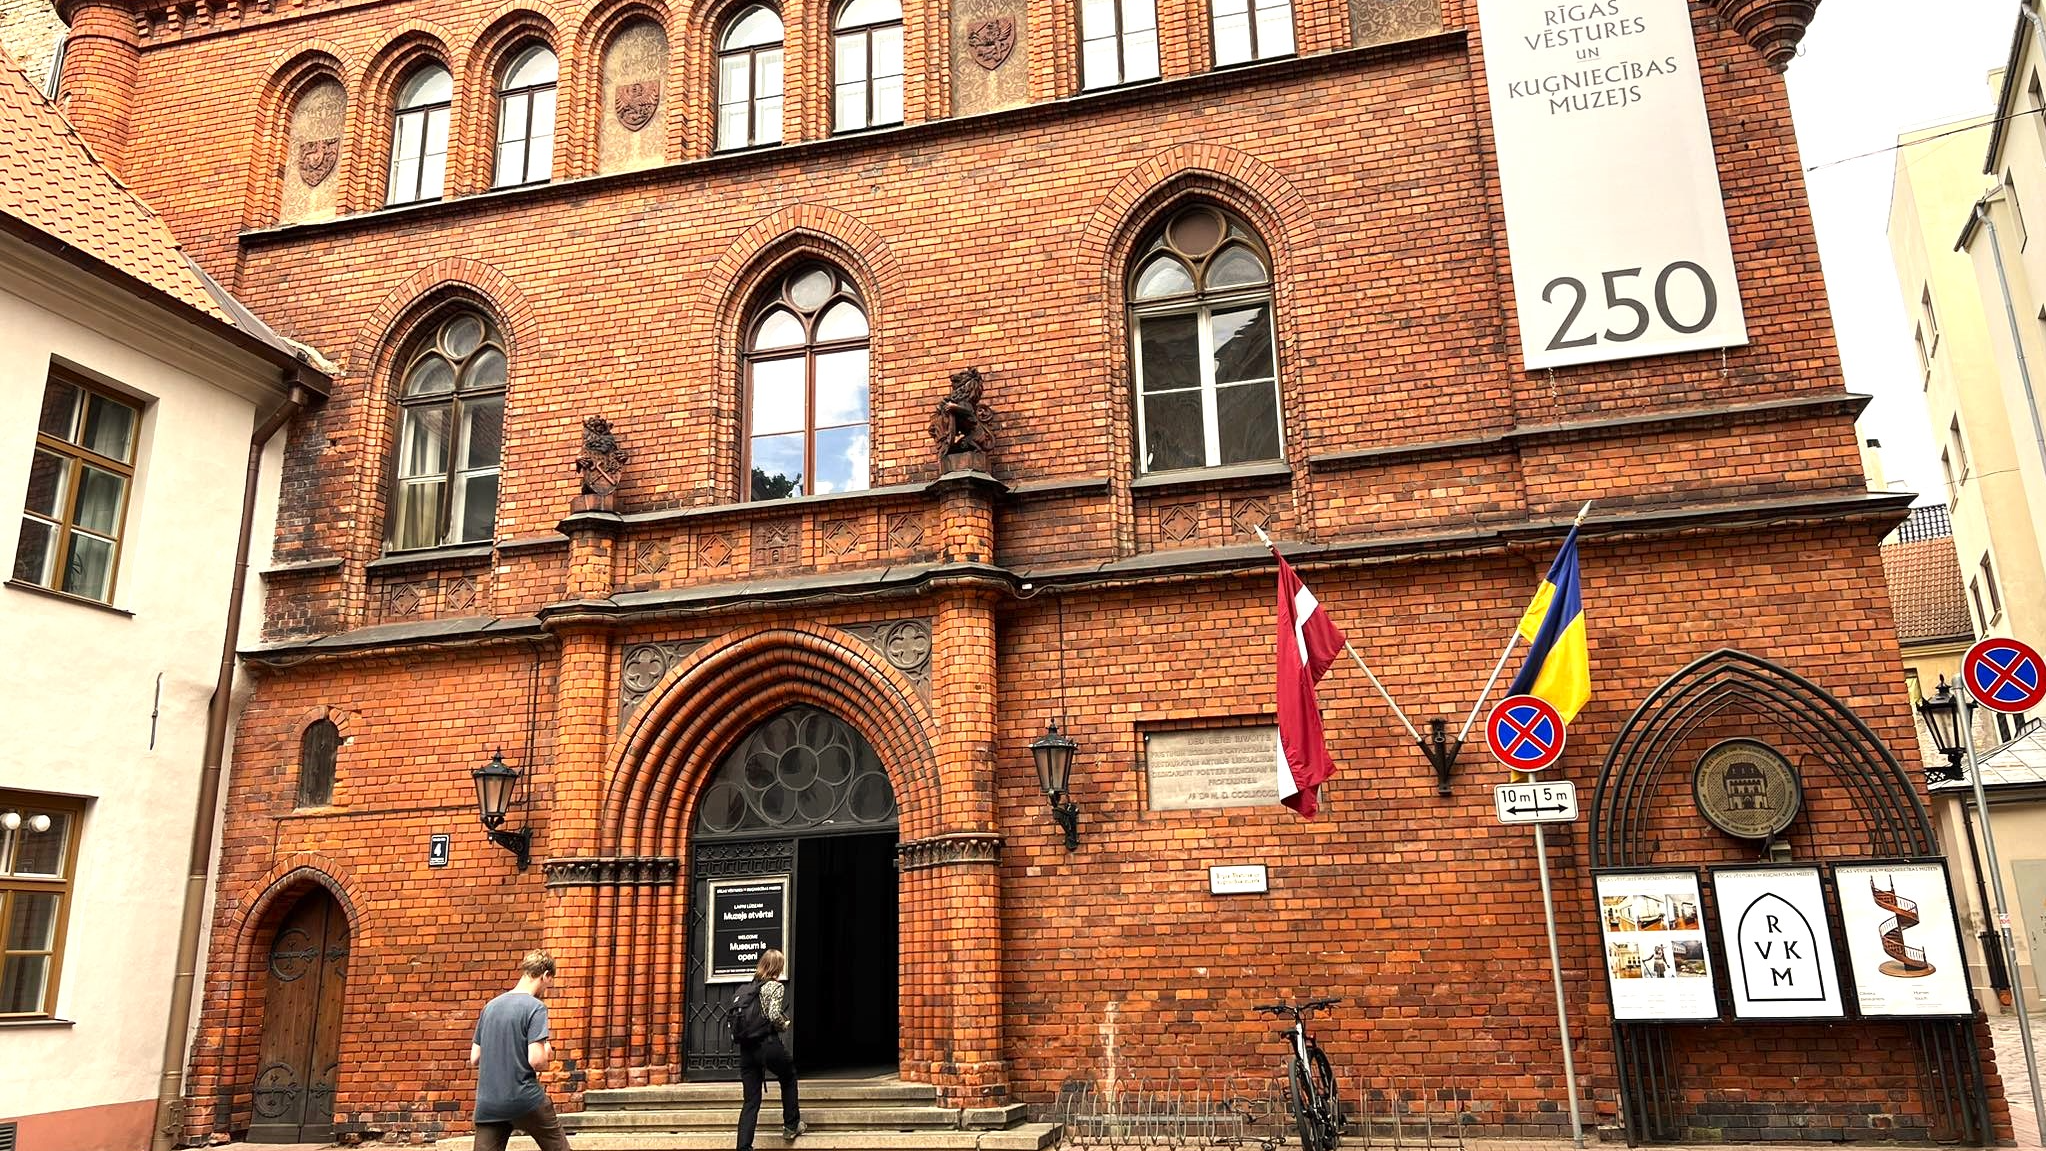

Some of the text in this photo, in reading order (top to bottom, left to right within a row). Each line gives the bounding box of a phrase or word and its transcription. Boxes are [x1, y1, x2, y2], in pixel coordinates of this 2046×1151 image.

[1544, 0, 1619, 26] RĪGAS
[1524, 17, 1646, 50] VĒSTURES
[1576, 47, 1600, 60] UN
[1508, 56, 1678, 99] KUĢNIECĪBAS
[1549, 86, 1642, 115] MUZEJS
[1542, 260, 1718, 351] 250
[1502, 790, 1530, 802] 10 m
[1544, 788, 1567, 800] 5 m
[434, 843, 442, 856] 4
[1766, 914, 1782, 933] R
[730, 942, 760, 950] Museum
[1754, 940, 1802, 960] V K
[1770, 968, 1794, 986] M
